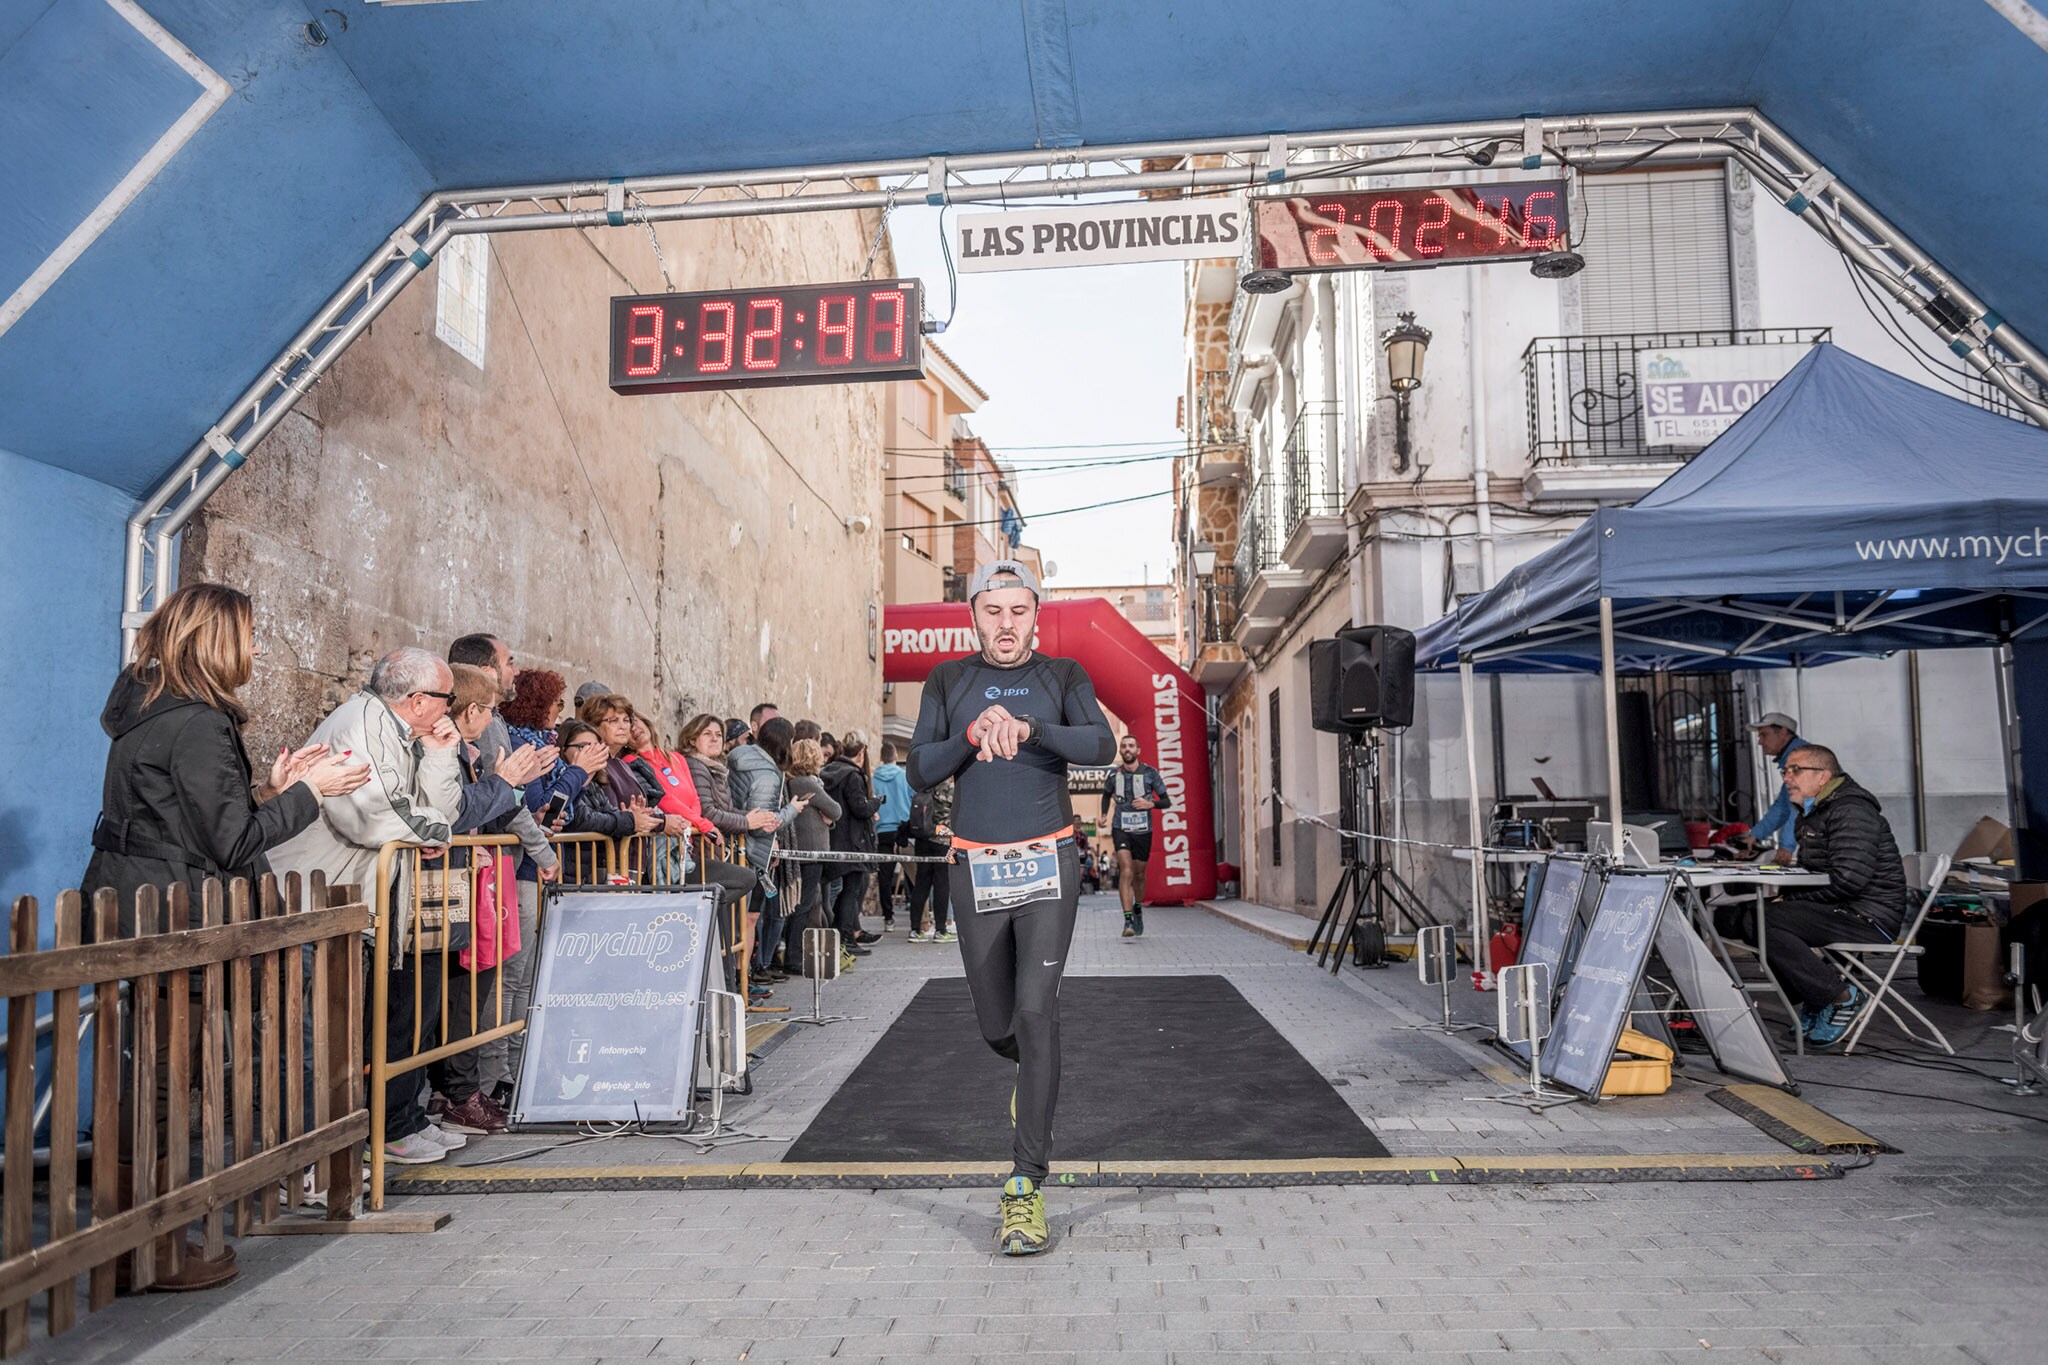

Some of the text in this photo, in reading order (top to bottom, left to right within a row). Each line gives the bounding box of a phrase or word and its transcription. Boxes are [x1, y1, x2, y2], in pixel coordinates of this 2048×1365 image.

[961, 211, 1239, 258] LAS PROVINCIAS
[627, 291, 905, 376] 3:32:47
[1650, 382, 1777, 414] SE ALQU
[1152, 673, 1187, 832] PROVINCIAS
[990, 860, 1039, 881] 1129
[1163, 834, 1192, 886] LAS
[557, 922, 674, 964] mychip
[547, 988, 688, 1011] www.mychip.es
[592, 1081, 652, 1092] @Mychip_Info
